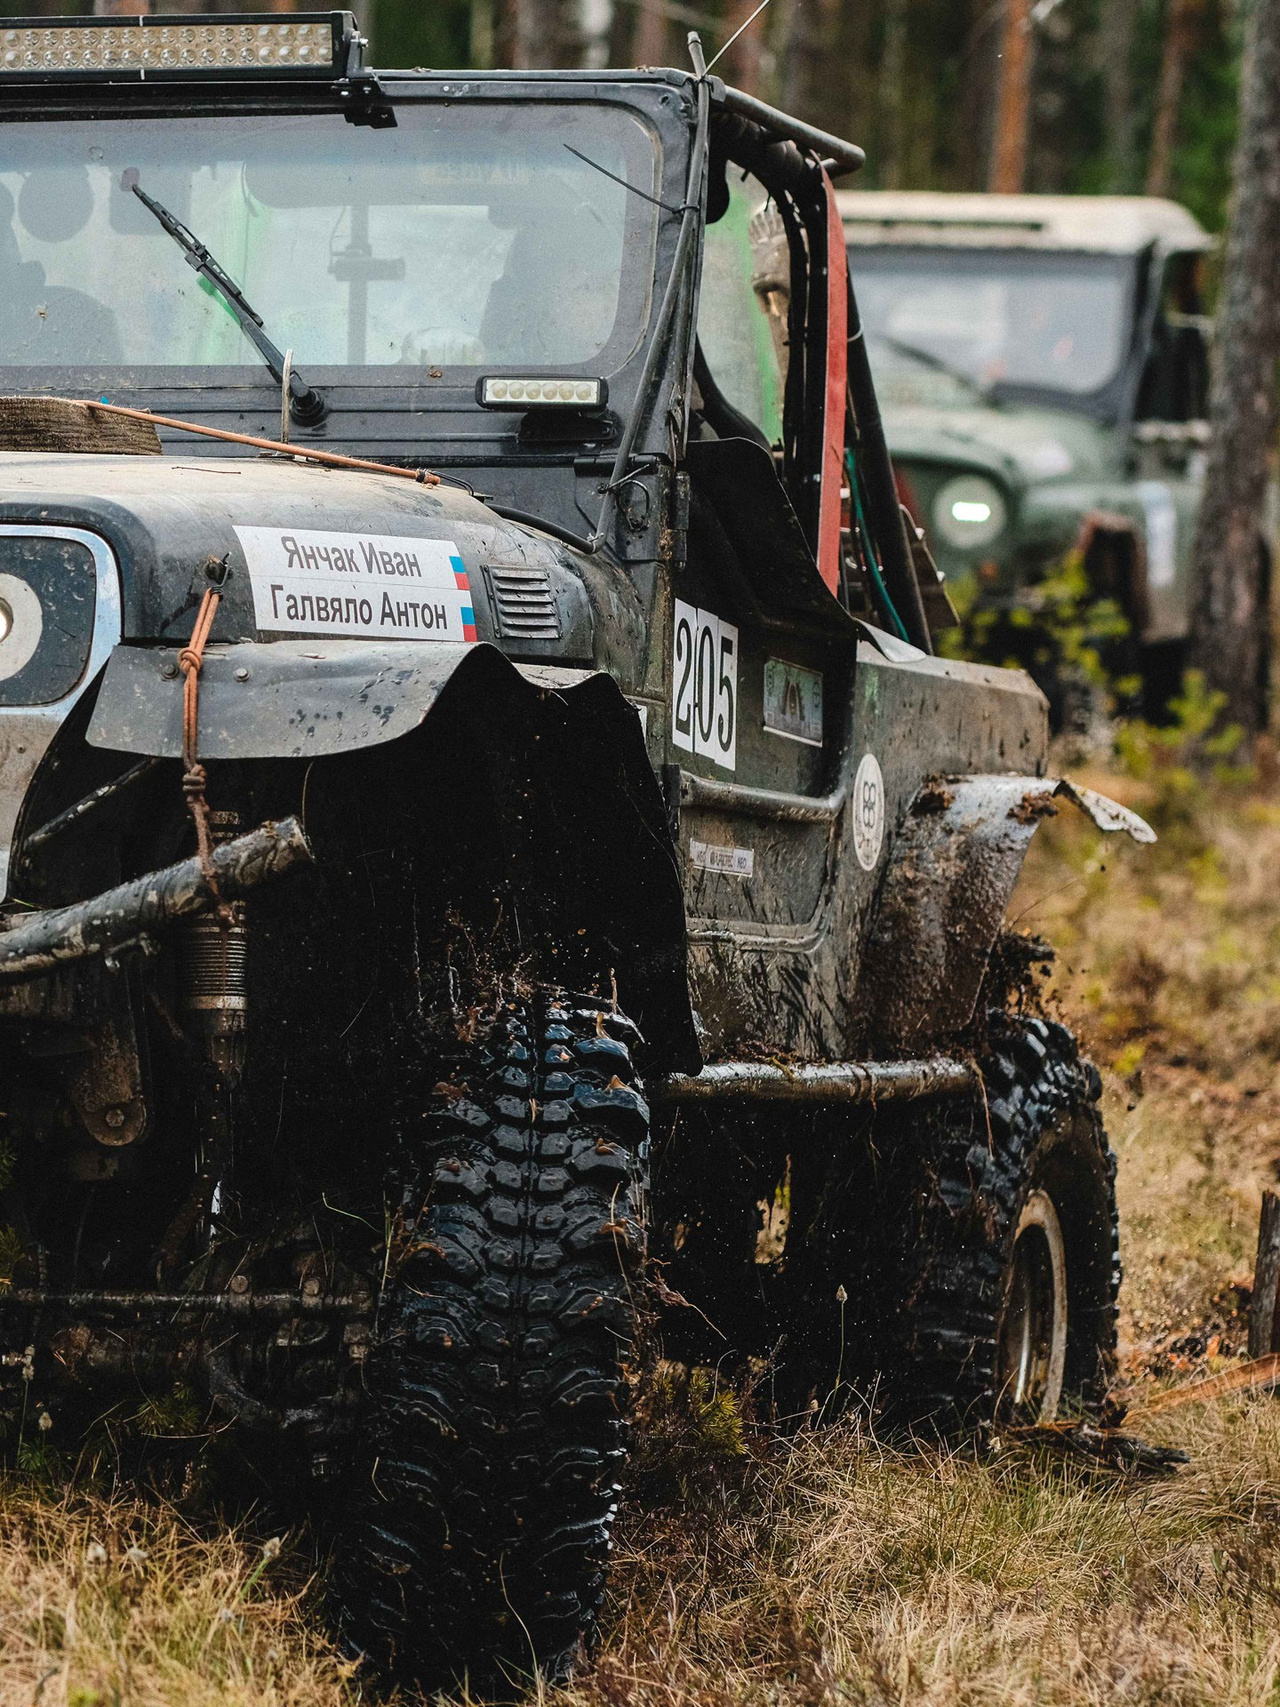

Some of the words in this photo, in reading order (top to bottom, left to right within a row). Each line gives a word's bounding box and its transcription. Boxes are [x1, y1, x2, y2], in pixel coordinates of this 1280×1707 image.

[280, 536, 360, 573] Янчак
[359, 541, 422, 577] Иван
[270, 584, 373, 625] Галвяло
[380, 591, 448, 630] Антон
[675, 617, 735, 752] 205
